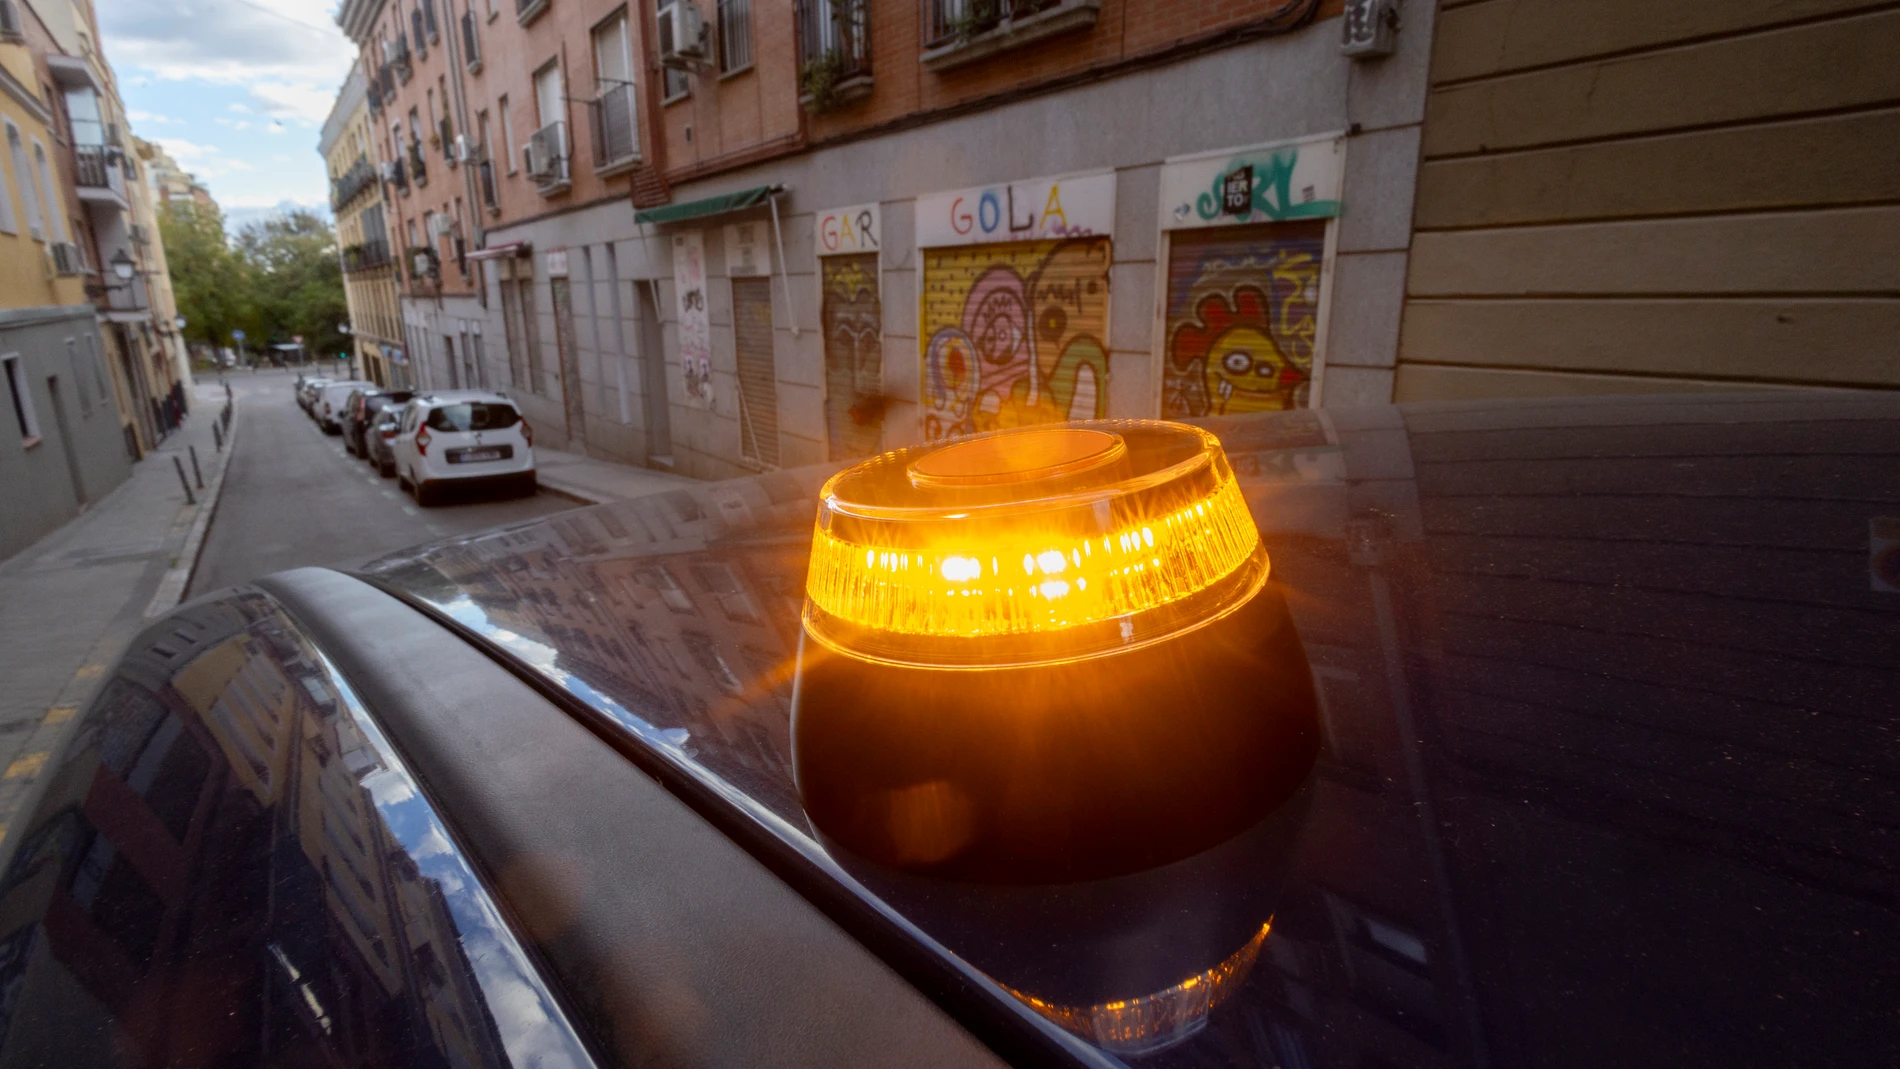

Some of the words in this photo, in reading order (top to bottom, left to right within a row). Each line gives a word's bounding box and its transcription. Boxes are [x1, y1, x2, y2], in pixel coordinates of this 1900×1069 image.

[951, 184, 1068, 234] GOLA
[1227, 194, 1244, 207] TO
[822, 210, 878, 252] GAR
